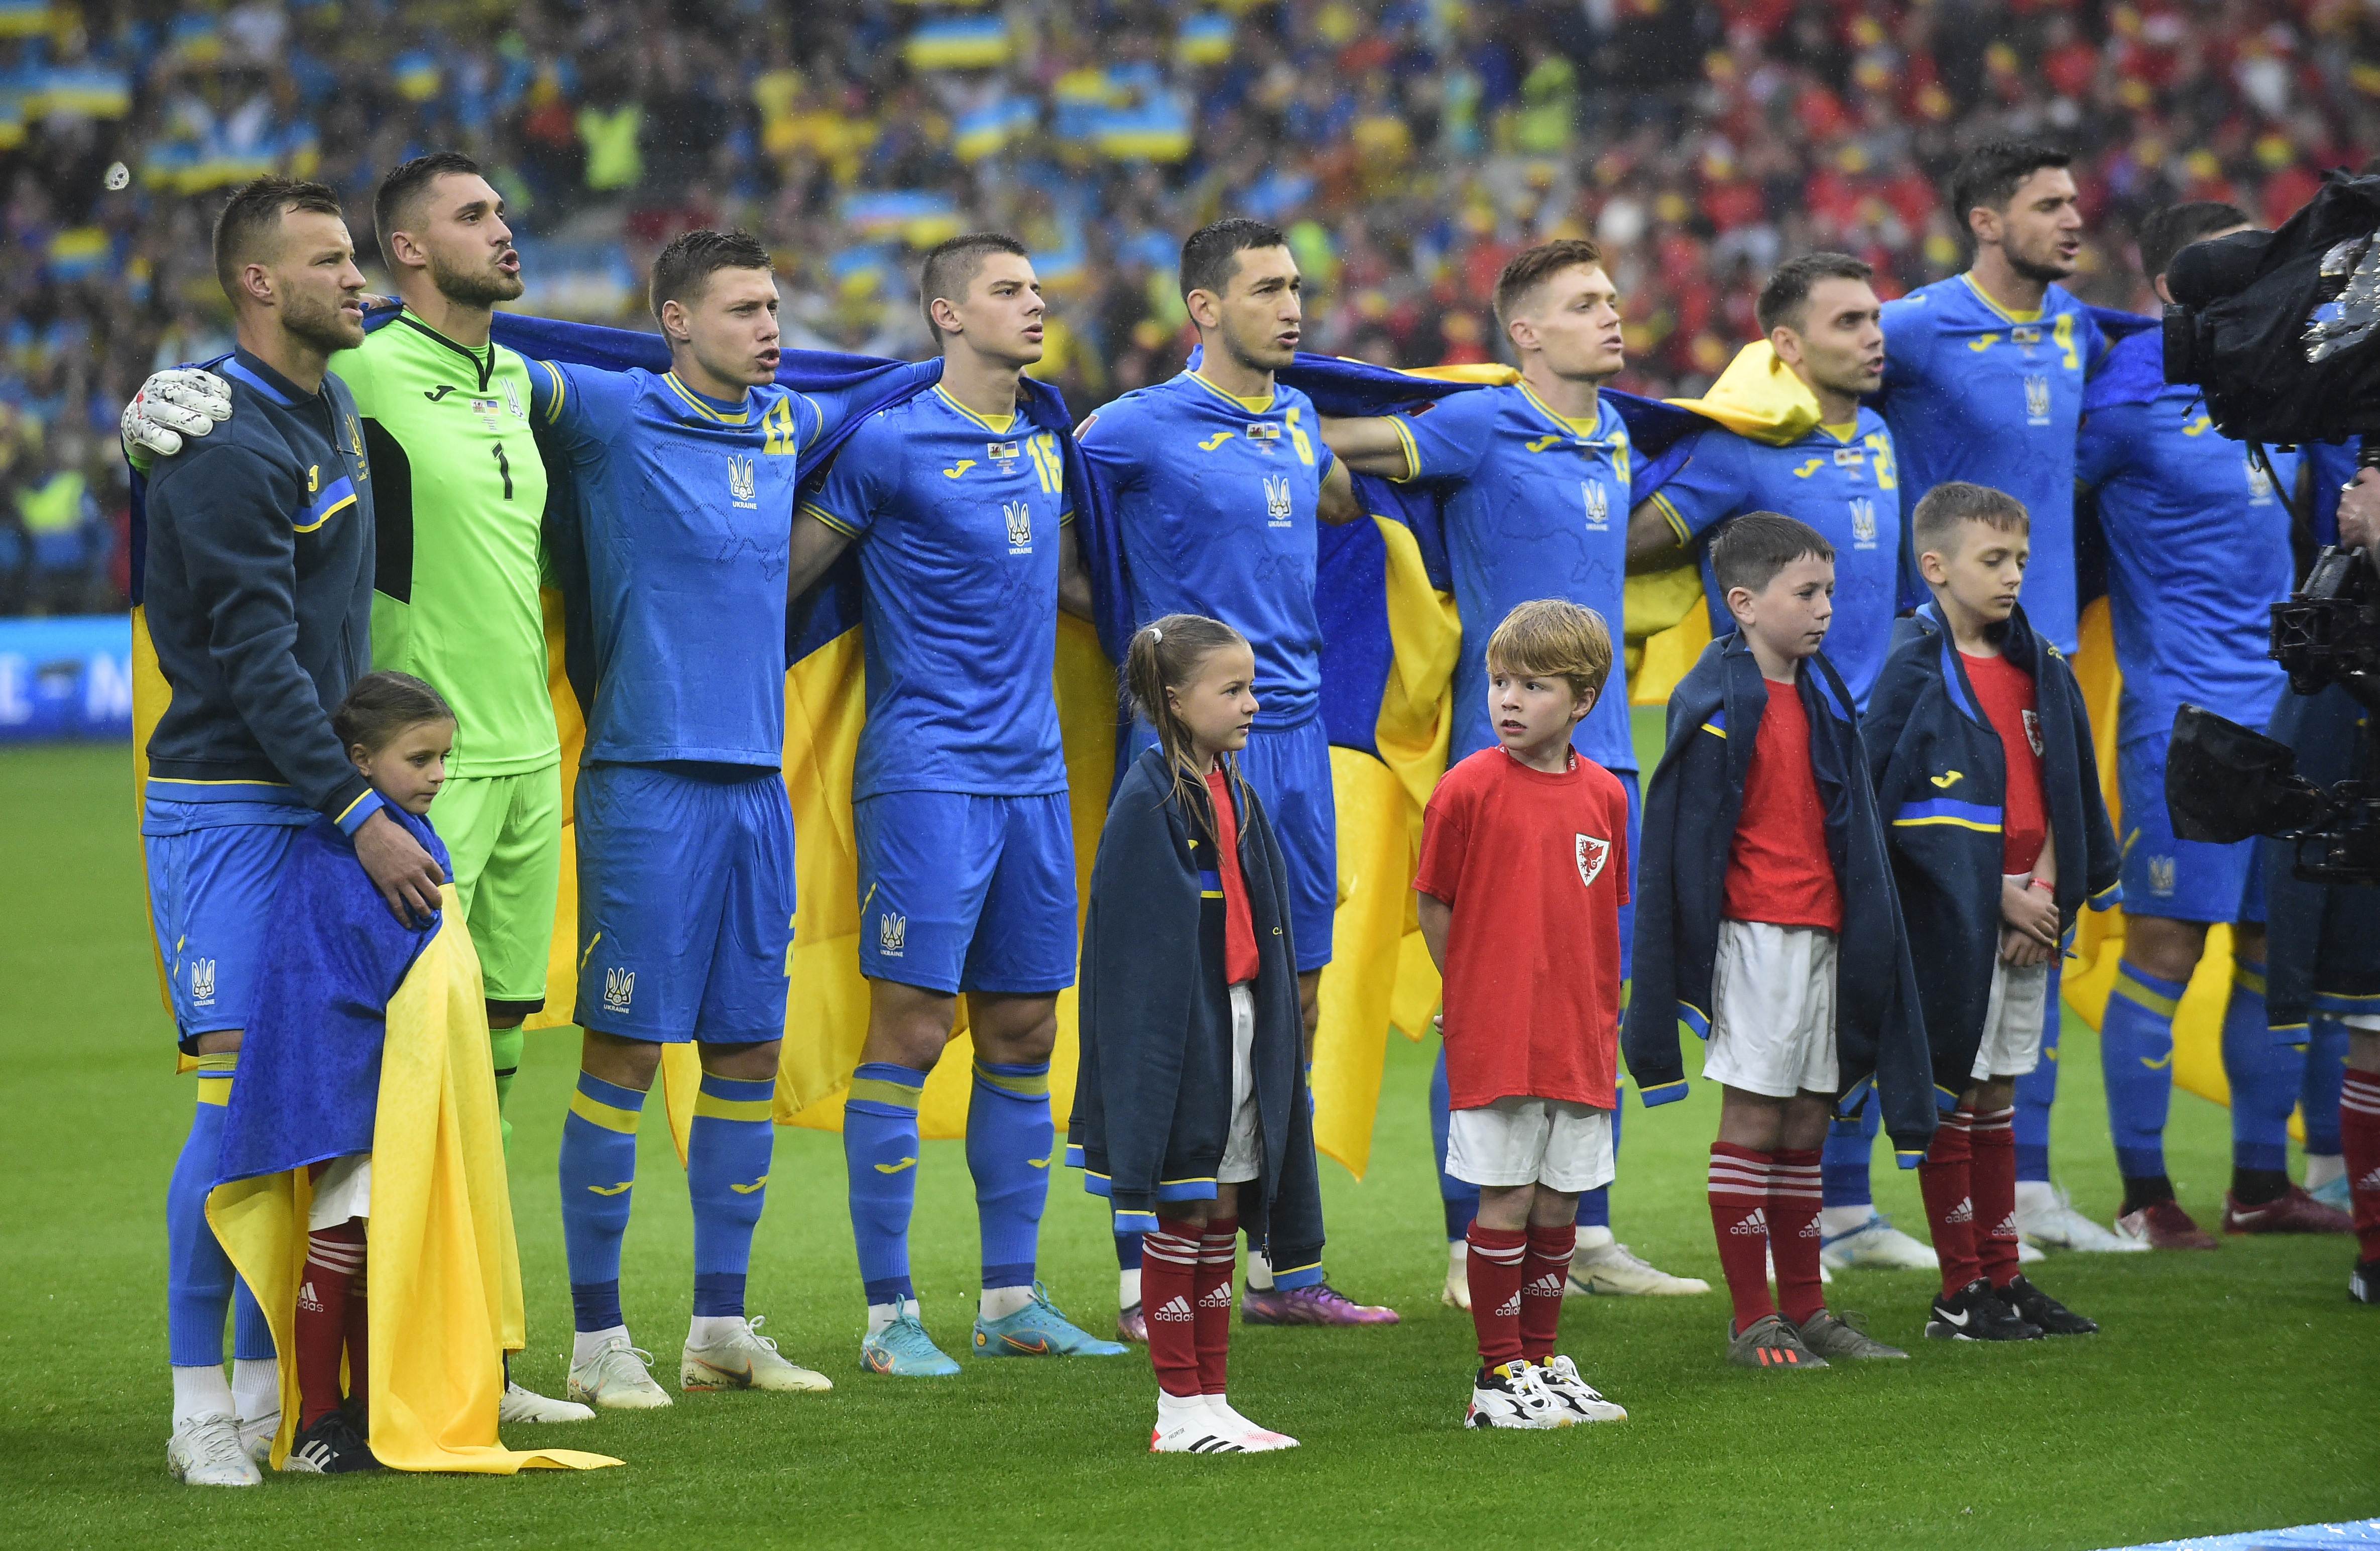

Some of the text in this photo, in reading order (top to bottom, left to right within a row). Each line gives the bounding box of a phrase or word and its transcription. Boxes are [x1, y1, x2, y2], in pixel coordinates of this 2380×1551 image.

[1025, 433, 1062, 493] 16
[491, 440, 514, 501] 1
[732, 501, 757, 510] UKRAINE
[1009, 546, 1032, 555] UKRAINE
[880, 949, 903, 957] UKRAINE
[193, 999, 215, 1007] UKRAINE
[604, 1004, 630, 1014] UKRAINE
[1522, 1286, 1564, 1297] adidas
[1199, 1297, 1231, 1308] adida
[1154, 1311, 1194, 1322] adidas
